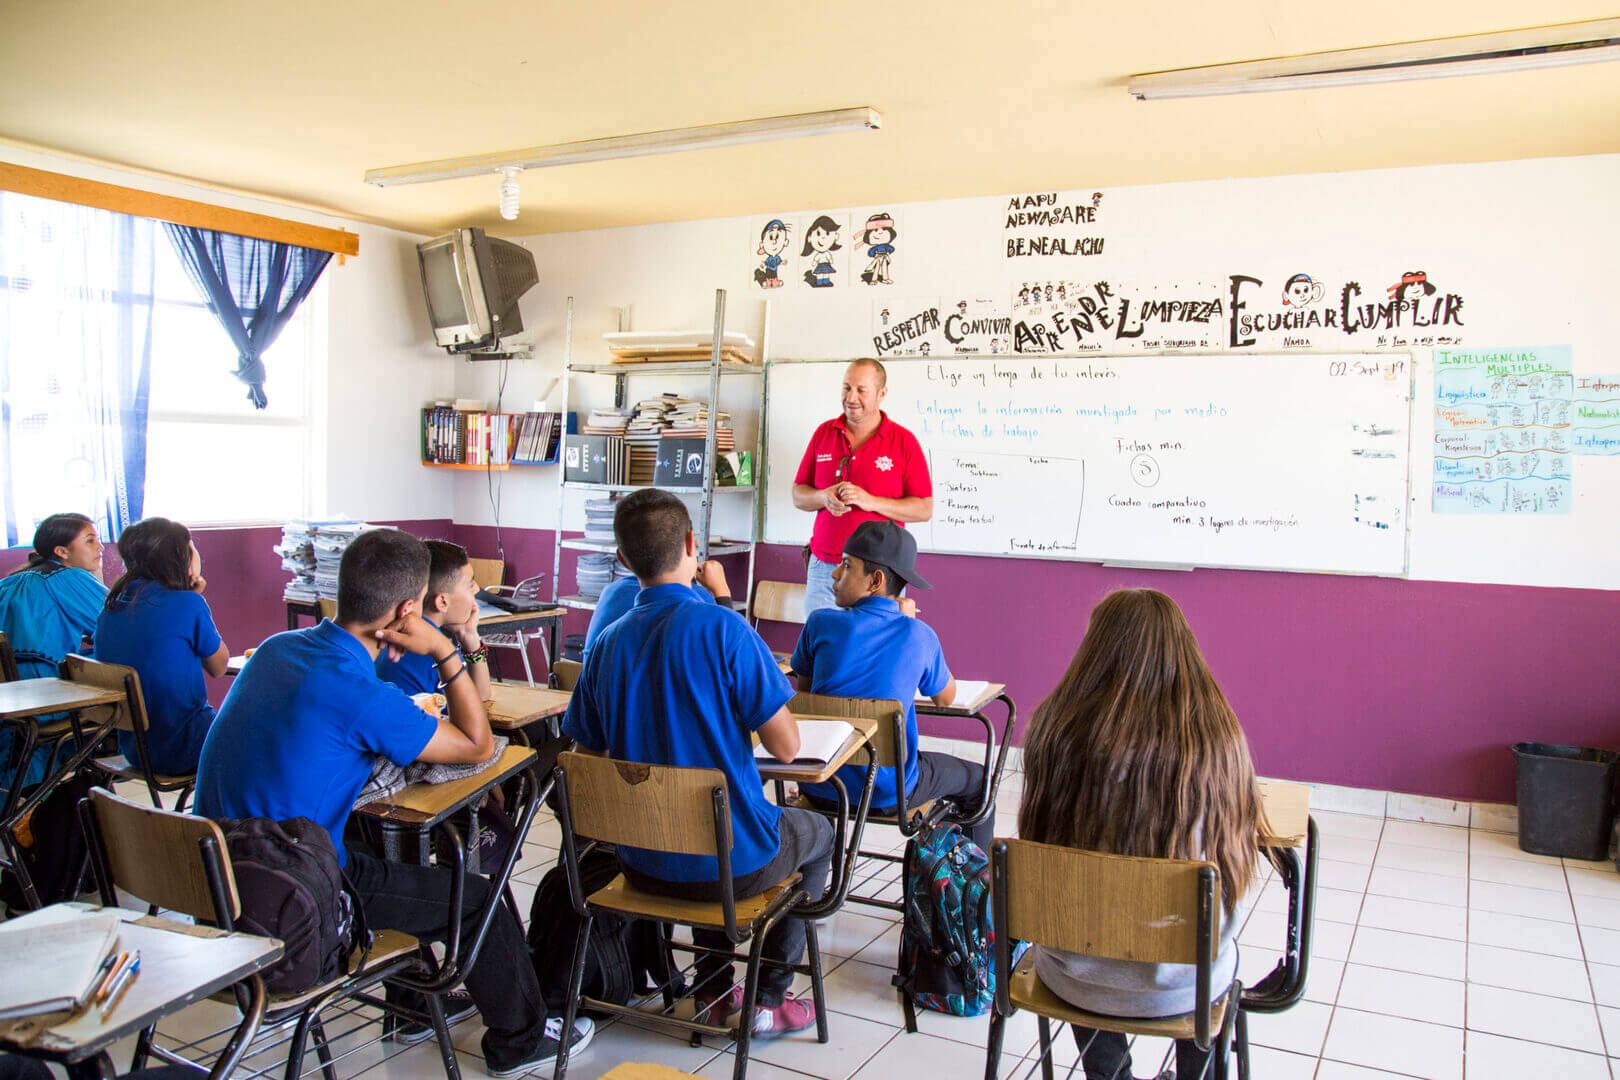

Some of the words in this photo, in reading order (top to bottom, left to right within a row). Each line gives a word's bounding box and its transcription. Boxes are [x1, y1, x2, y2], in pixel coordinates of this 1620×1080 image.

[943, 314, 1012, 344] CONVIVIR
[1116, 297, 1222, 340] LIMPIEZA
[1229, 275, 1338, 348] ESCUCHAR
[1341, 281, 1464, 335] CUMPLIR
[873, 308, 940, 356] RESPETAR
[1030, 366, 1043, 379] de
[1440, 352, 1537, 364] INTELIGENCIAS
